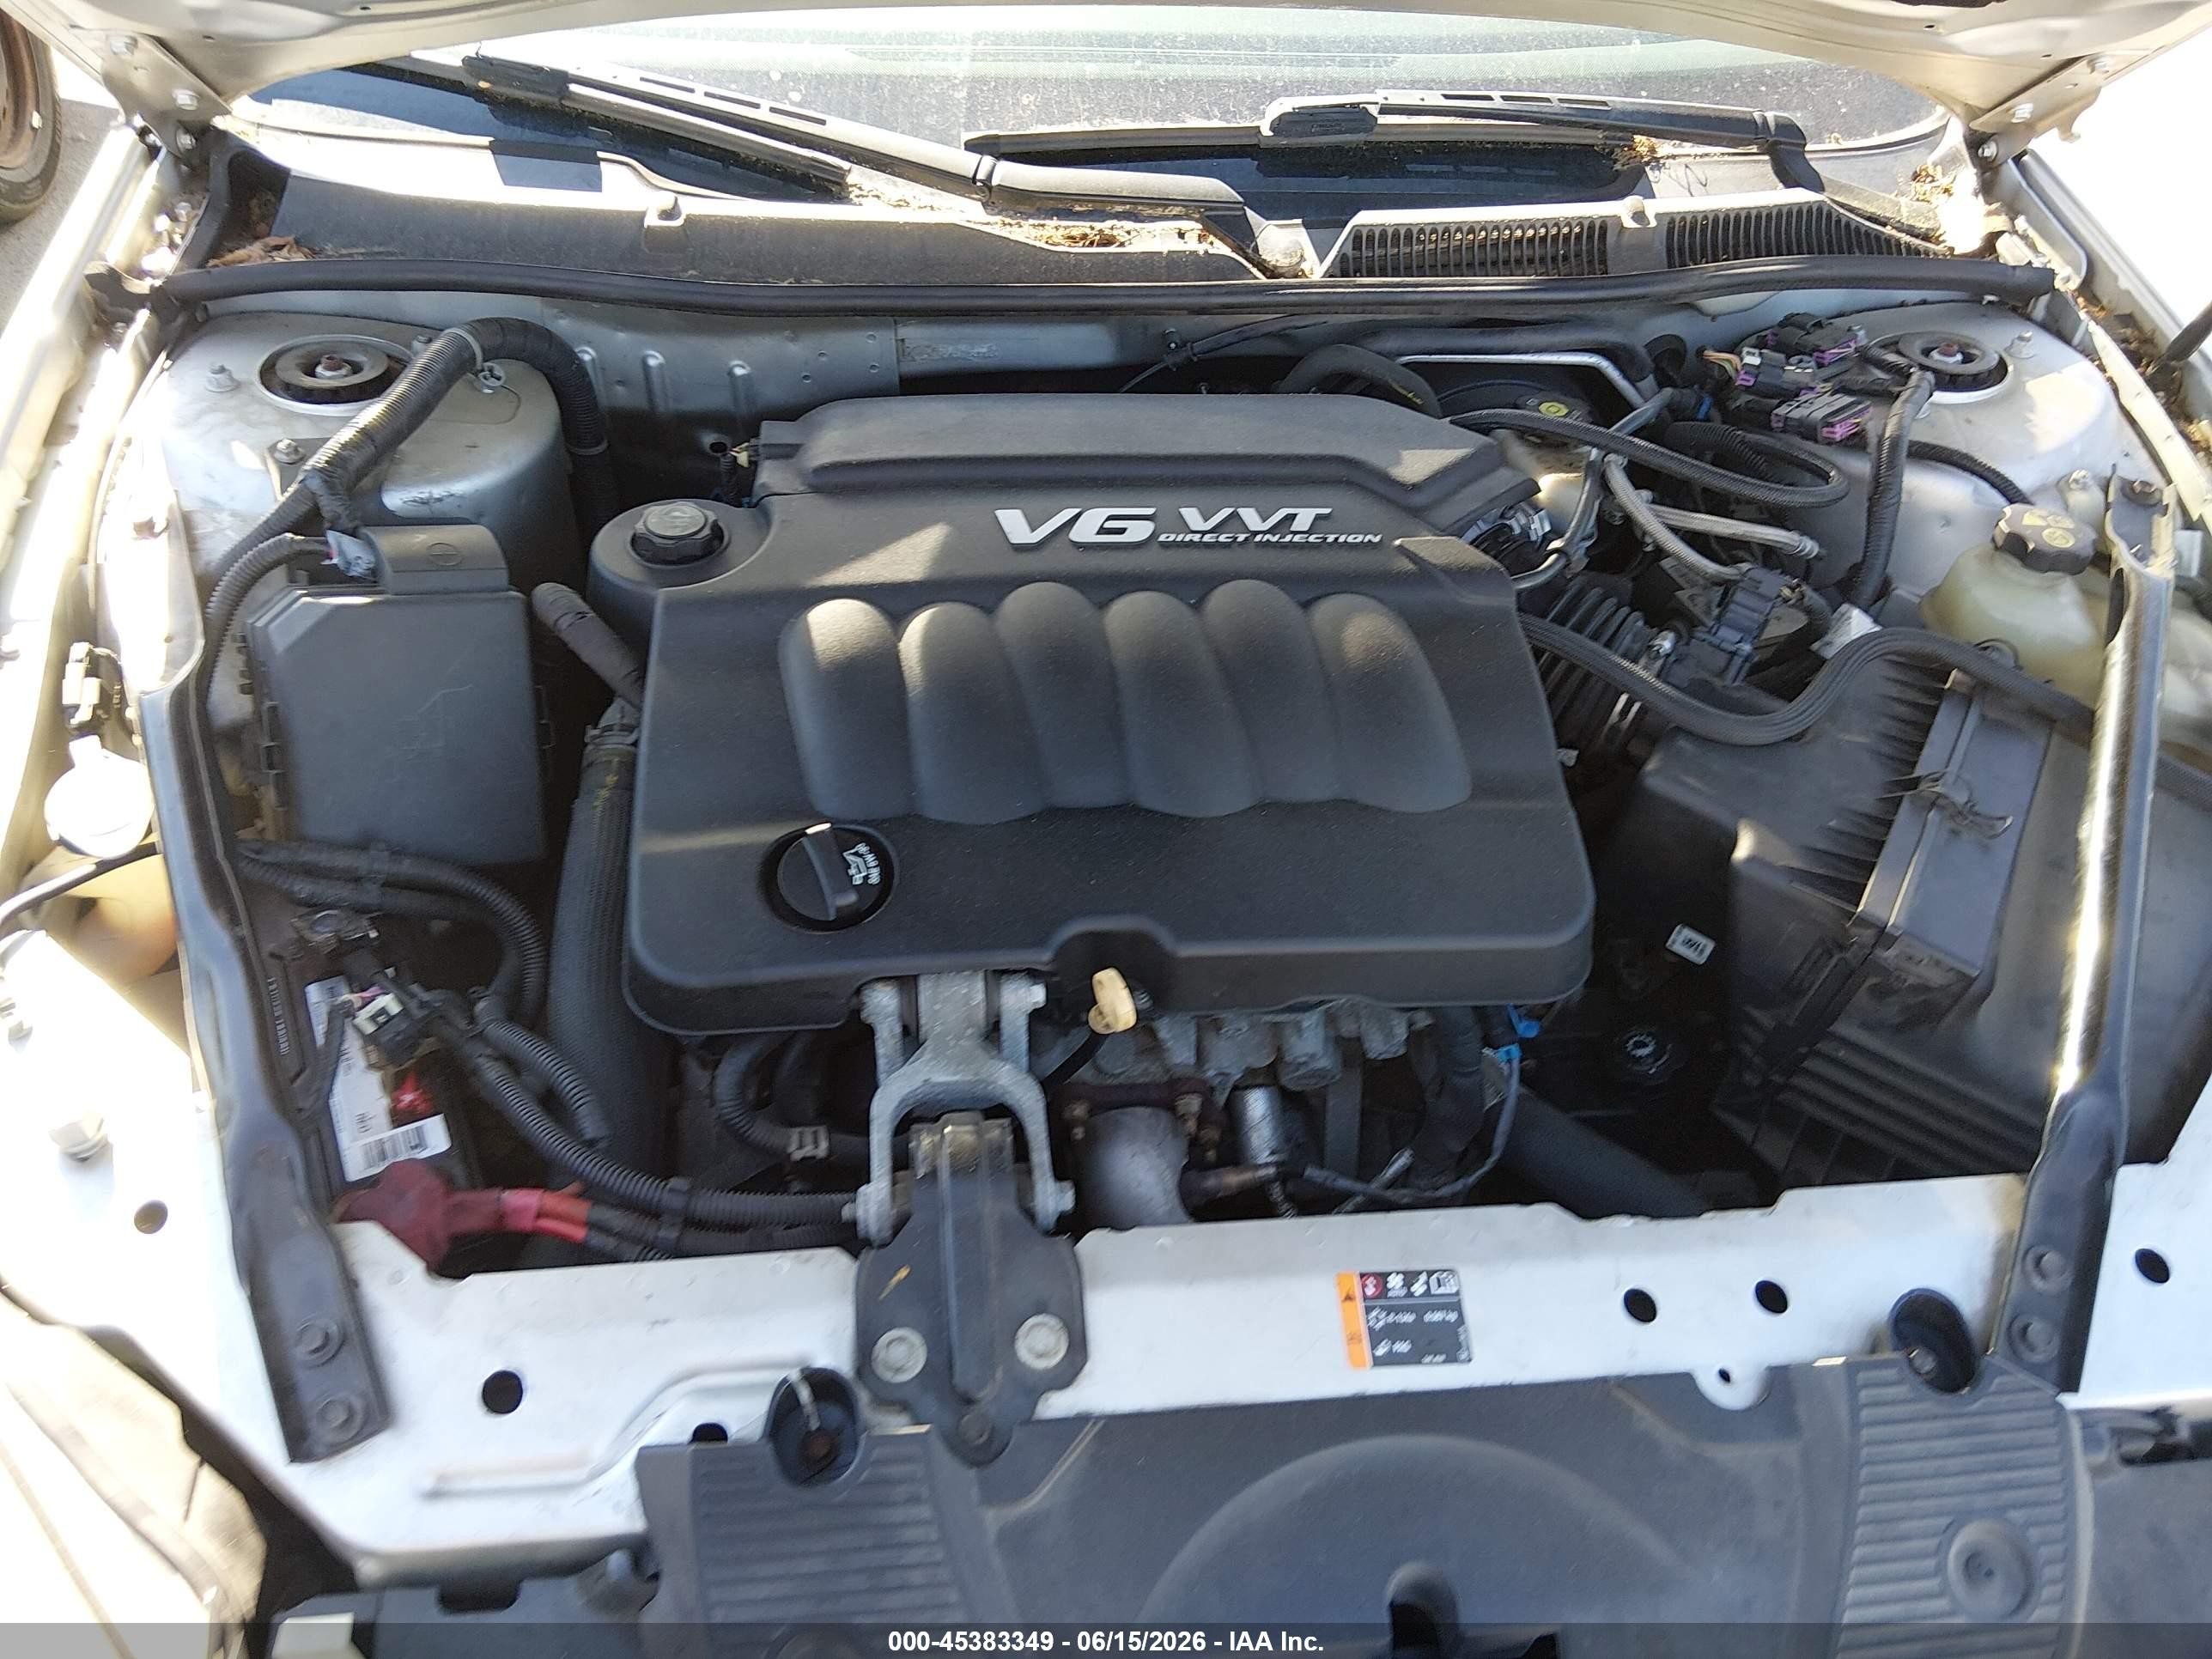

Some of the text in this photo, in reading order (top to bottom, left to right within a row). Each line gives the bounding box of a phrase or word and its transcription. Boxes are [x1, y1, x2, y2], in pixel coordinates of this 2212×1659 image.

[994, 507, 1333, 544] V6 VVT
[1157, 532, 1382, 544] DIRECT INJECTION
